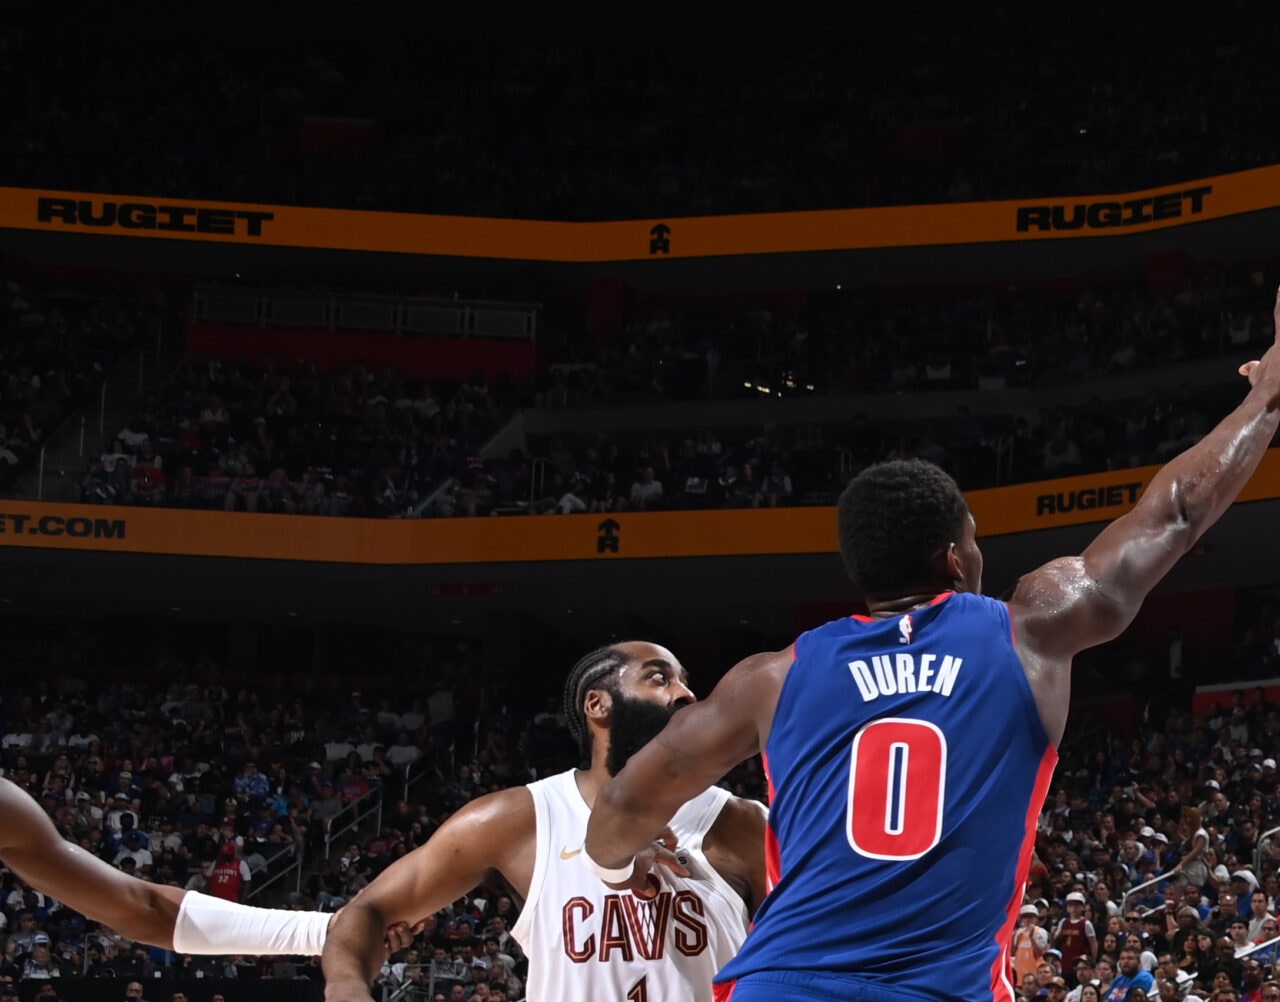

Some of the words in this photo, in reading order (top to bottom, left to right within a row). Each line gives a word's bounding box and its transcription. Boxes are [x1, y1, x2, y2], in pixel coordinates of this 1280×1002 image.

[37, 197, 274, 237] RUGIET
[1016, 185, 1213, 233] RUGIET
[1035, 481, 1142, 518] RUGIET
[848, 653, 963, 702] DUREN
[846, 717, 947, 861] 0
[562, 889, 708, 964] CAVS
